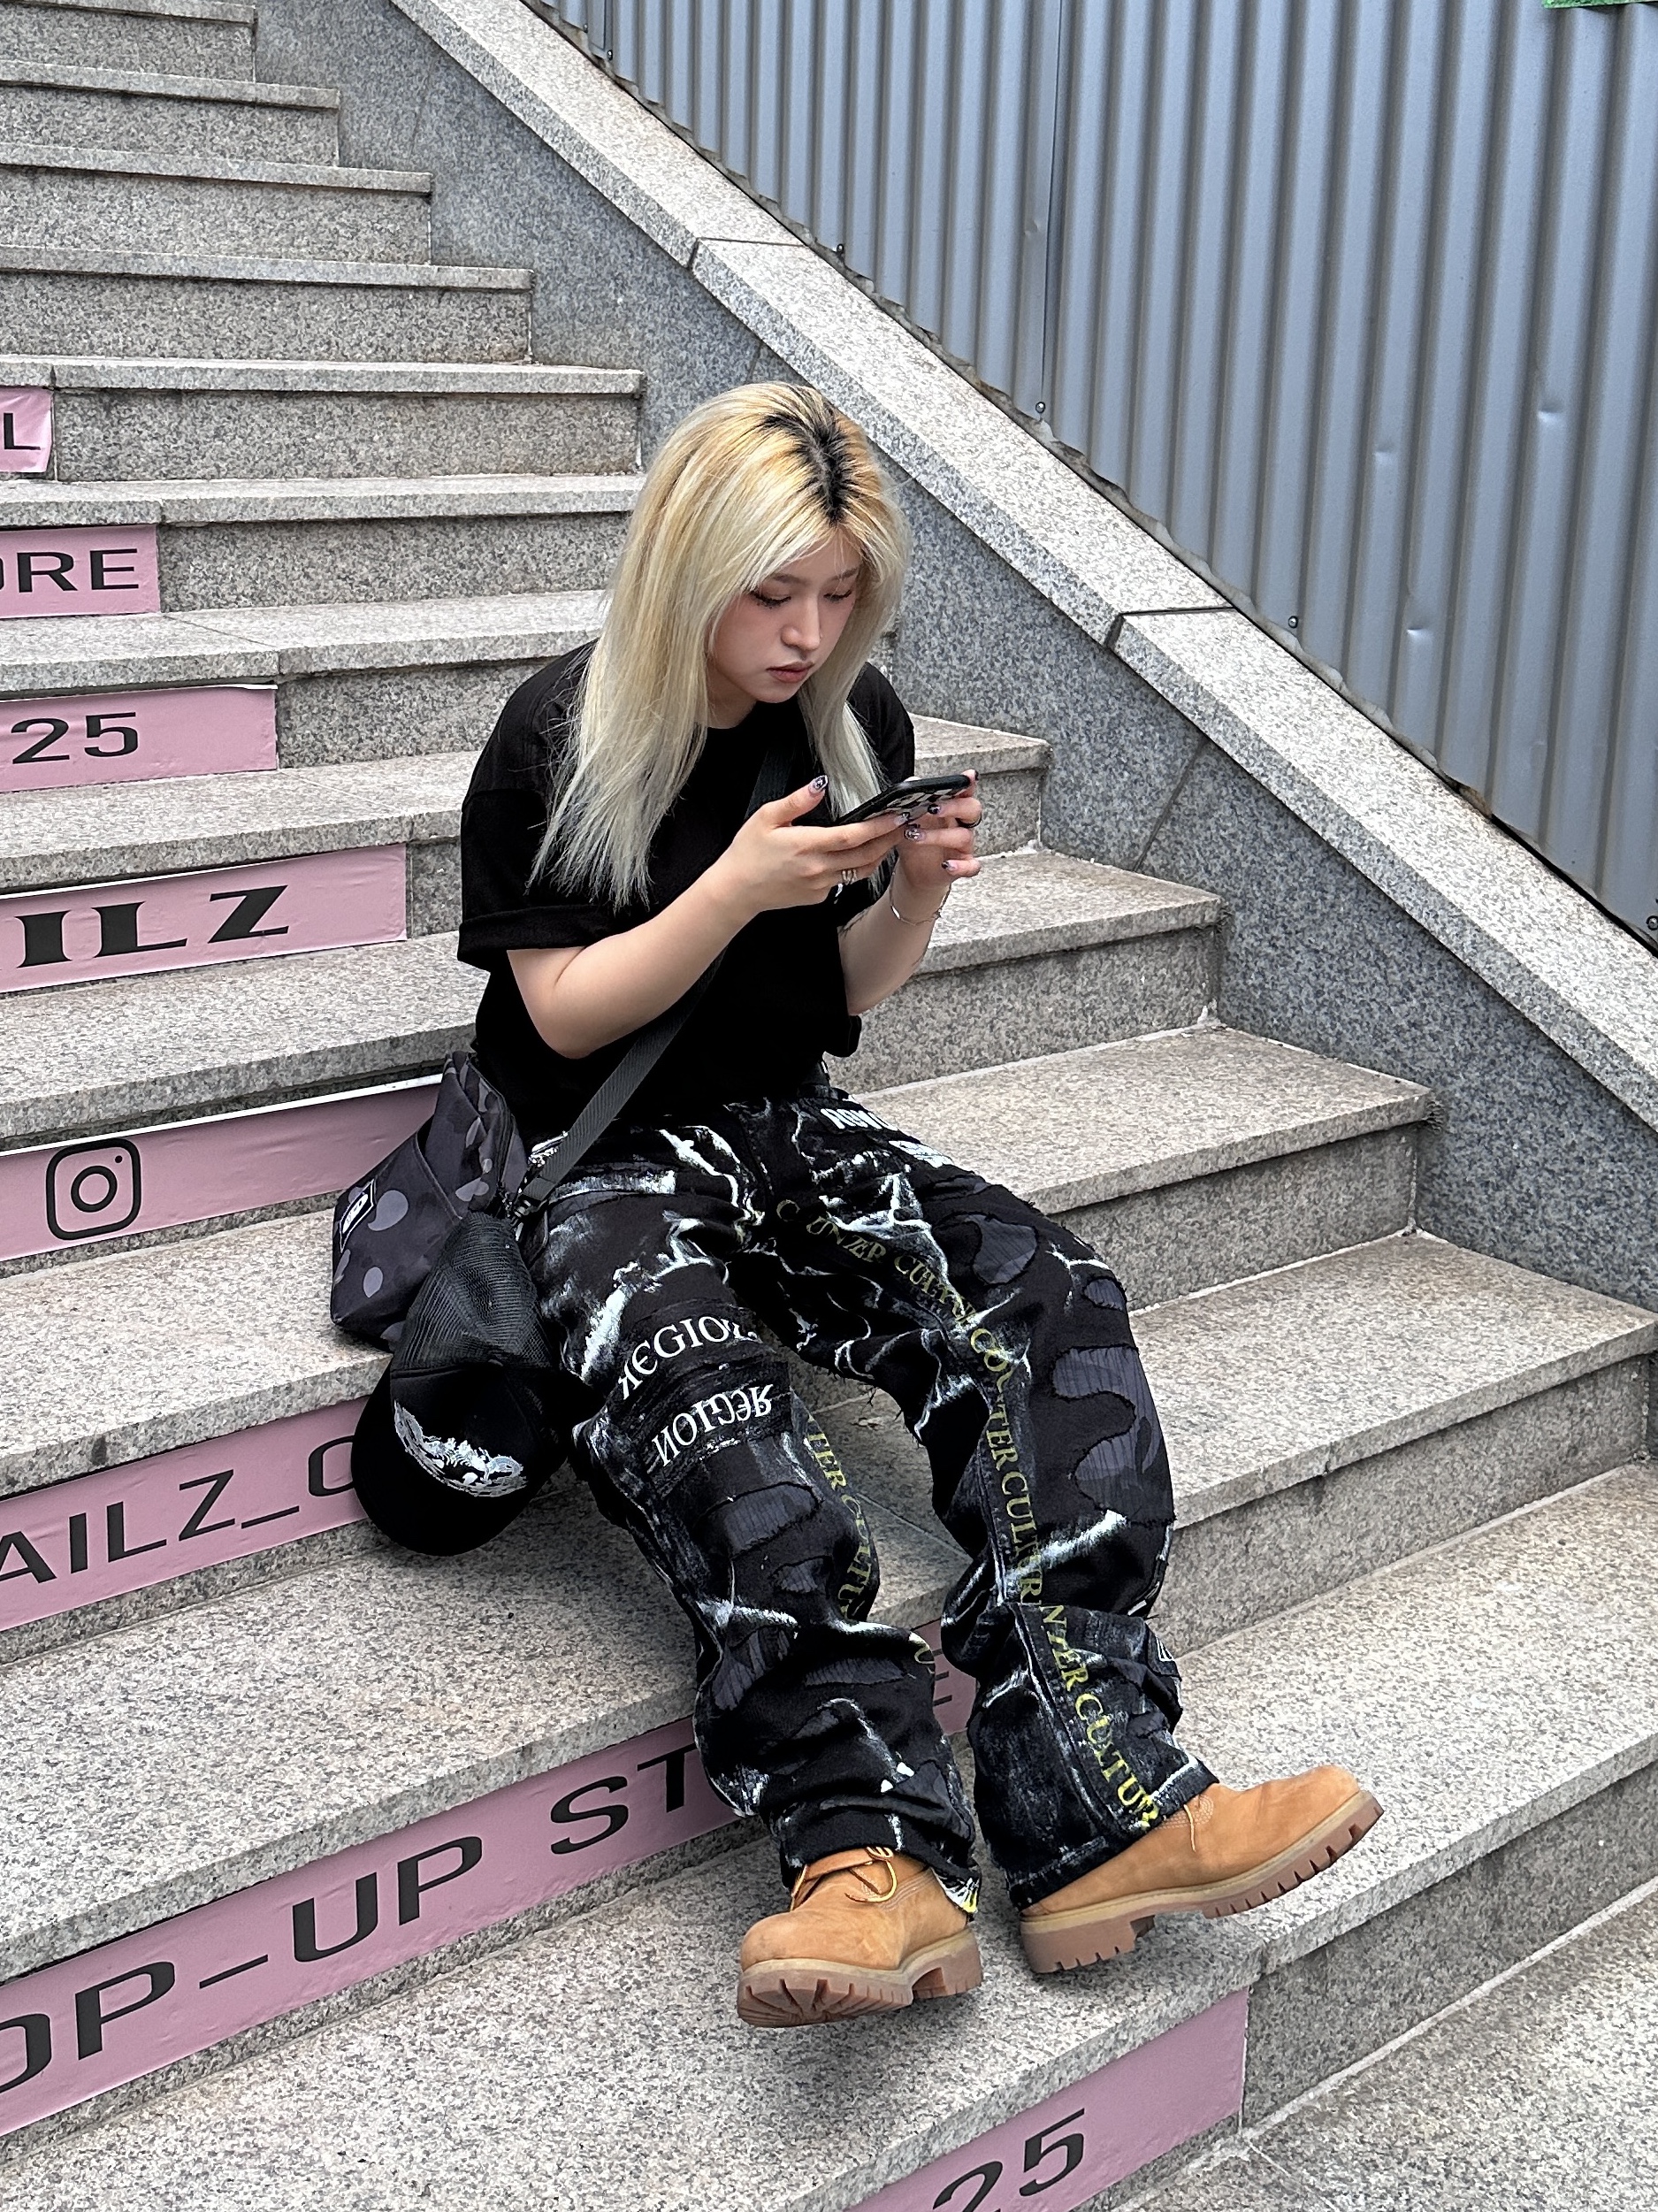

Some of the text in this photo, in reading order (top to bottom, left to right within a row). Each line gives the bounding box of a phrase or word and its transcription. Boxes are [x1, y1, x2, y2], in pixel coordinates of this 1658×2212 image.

[0, 548, 140, 593] RE
[11, 712, 139, 764] 25
[15, 884, 290, 968] ILZ
